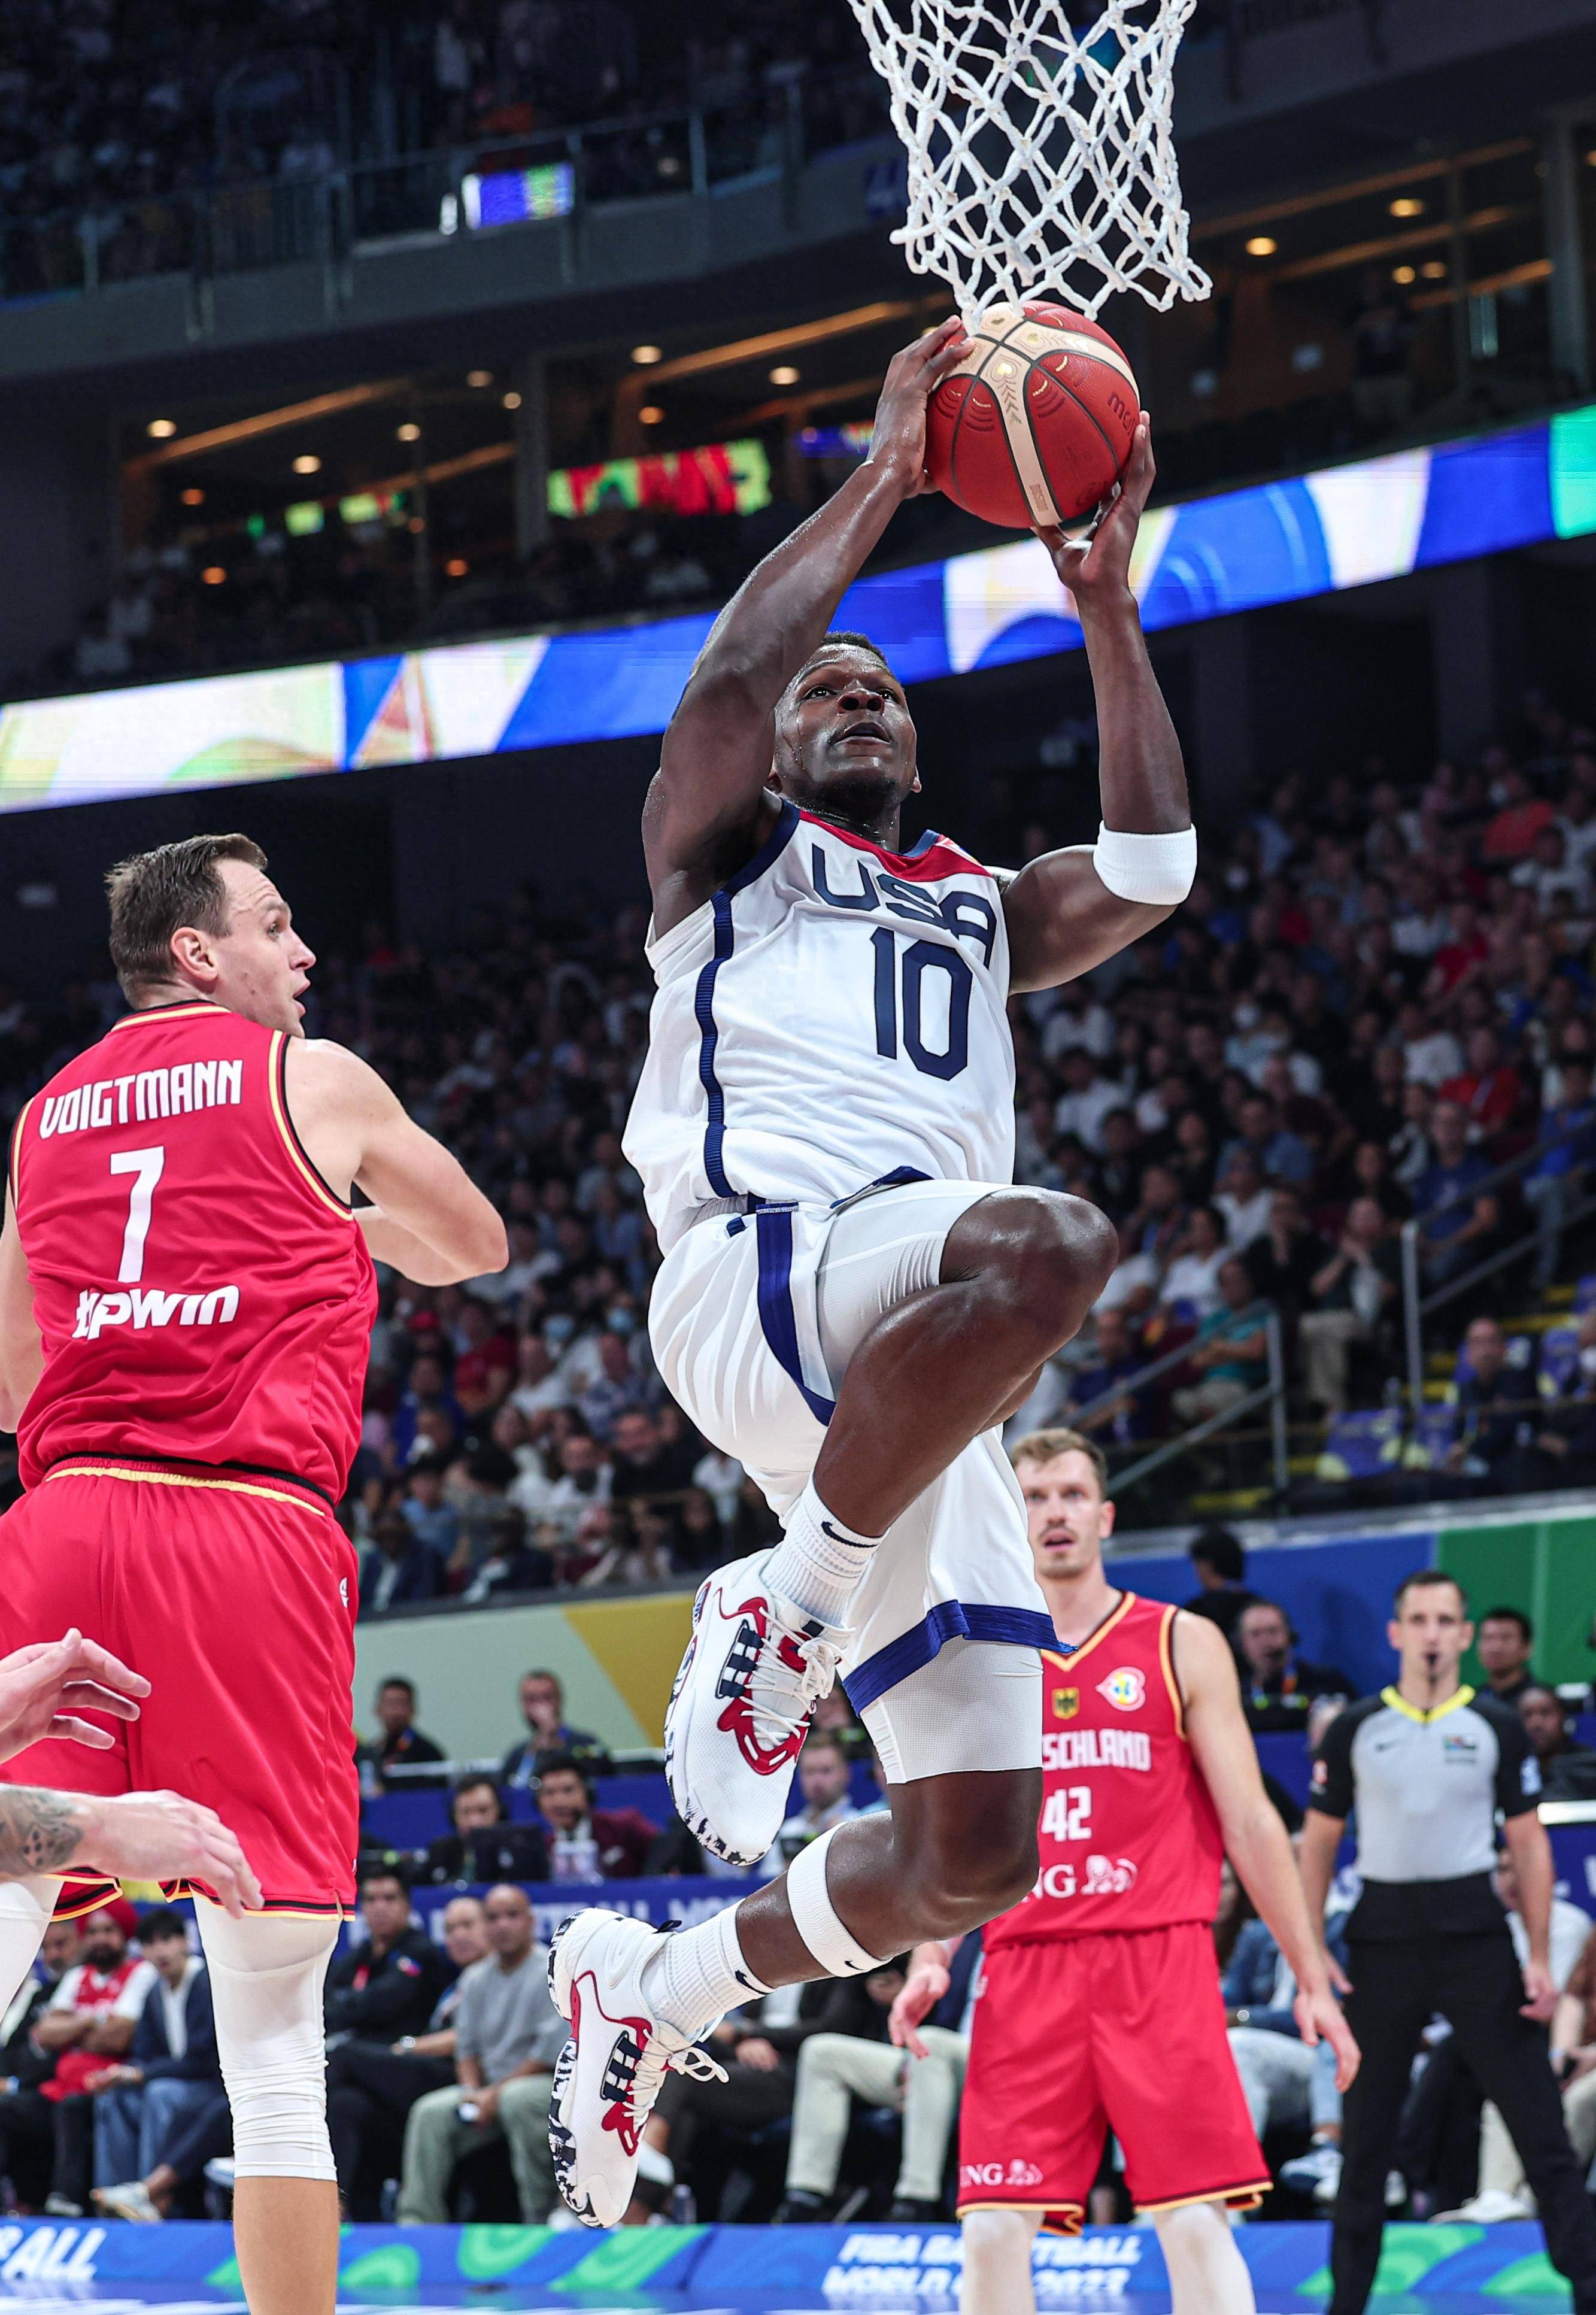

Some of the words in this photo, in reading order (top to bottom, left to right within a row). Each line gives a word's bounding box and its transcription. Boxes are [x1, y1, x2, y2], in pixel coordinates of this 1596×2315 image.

[812, 843, 997, 970] USA
[870, 926, 973, 1081] 10
[39, 1060, 242, 1139] VOIGTMANN
[110, 1145, 165, 1284] 7
[1042, 1728, 1151, 1772] SCHLAND
[1042, 1786, 1092, 1842] 42
